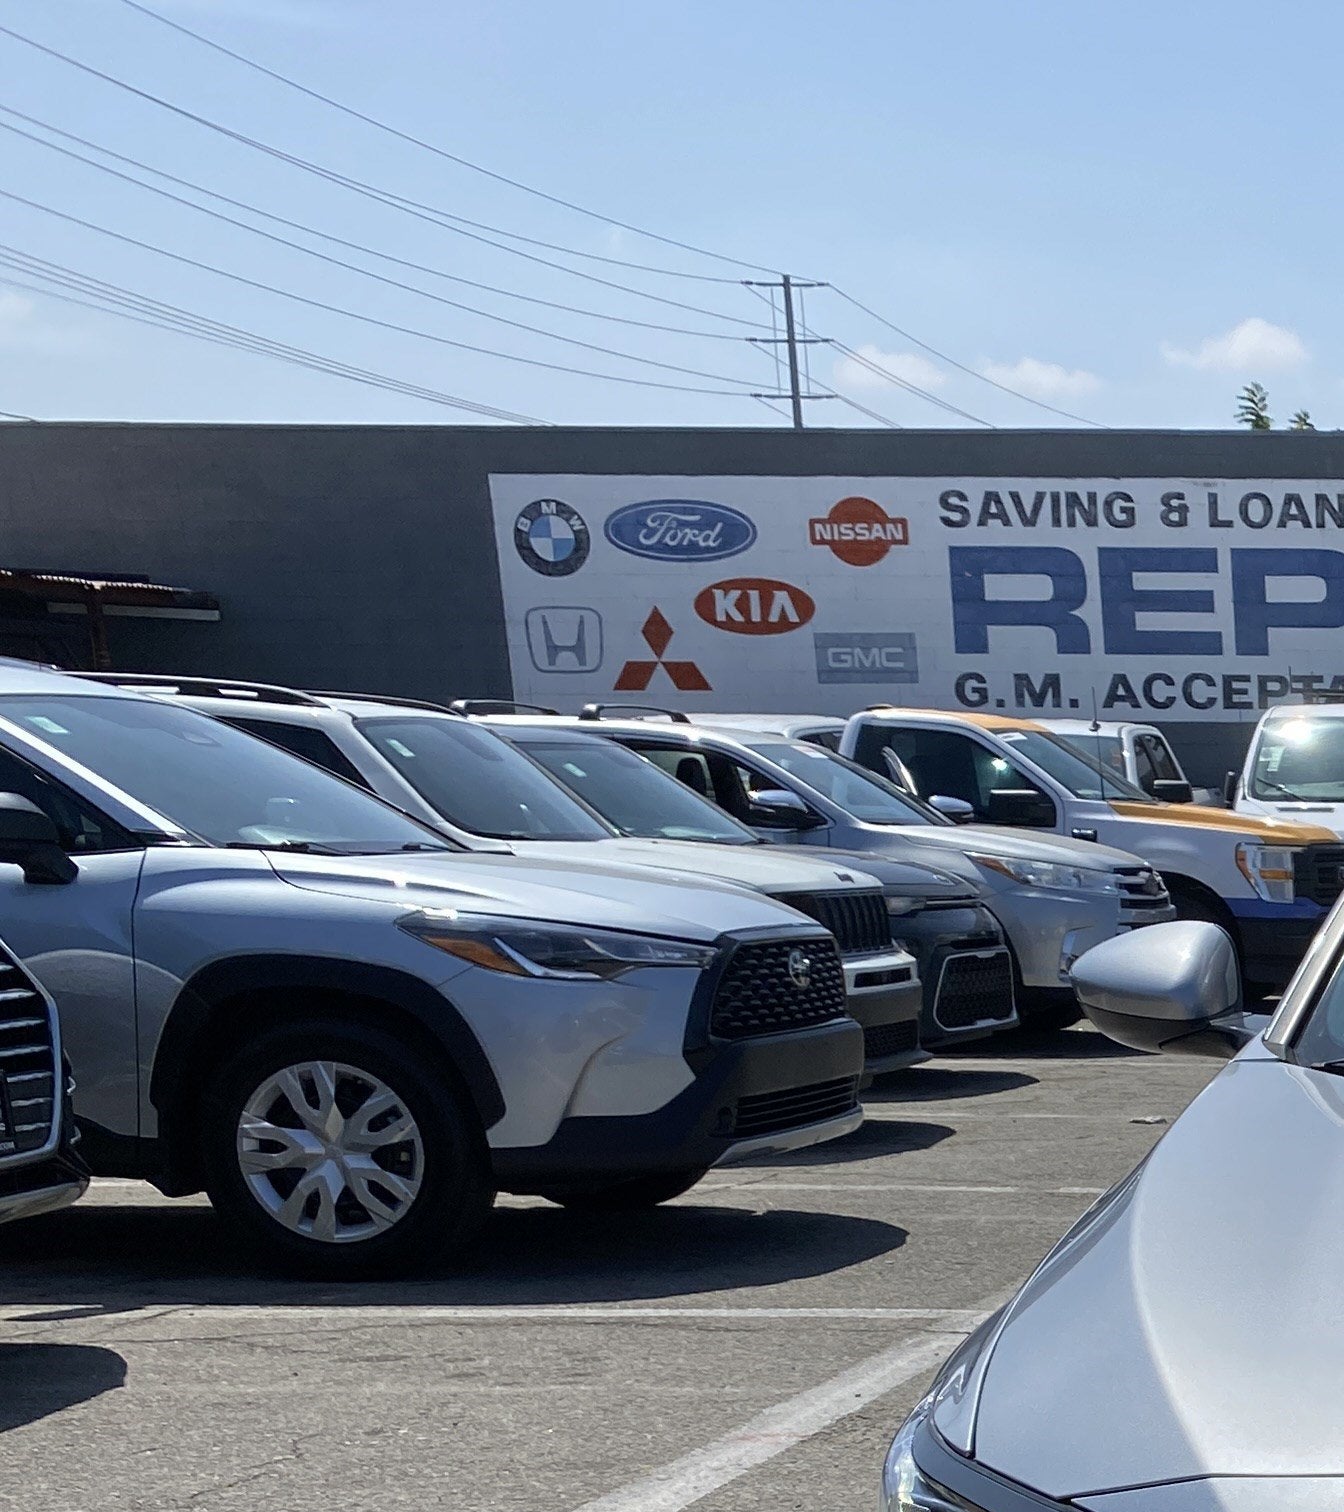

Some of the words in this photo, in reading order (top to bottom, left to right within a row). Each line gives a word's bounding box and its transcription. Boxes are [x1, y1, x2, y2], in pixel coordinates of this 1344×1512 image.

[516, 501, 587, 533] BMW
[637, 503, 724, 550] Ford
[939, 490, 1137, 531] SAVING
[1160, 493, 1191, 529] &
[814, 521, 904, 542] NISSAN
[713, 588, 801, 624] KIA
[826, 646, 904, 670] GMC
[954, 673, 1080, 710] G.M.
